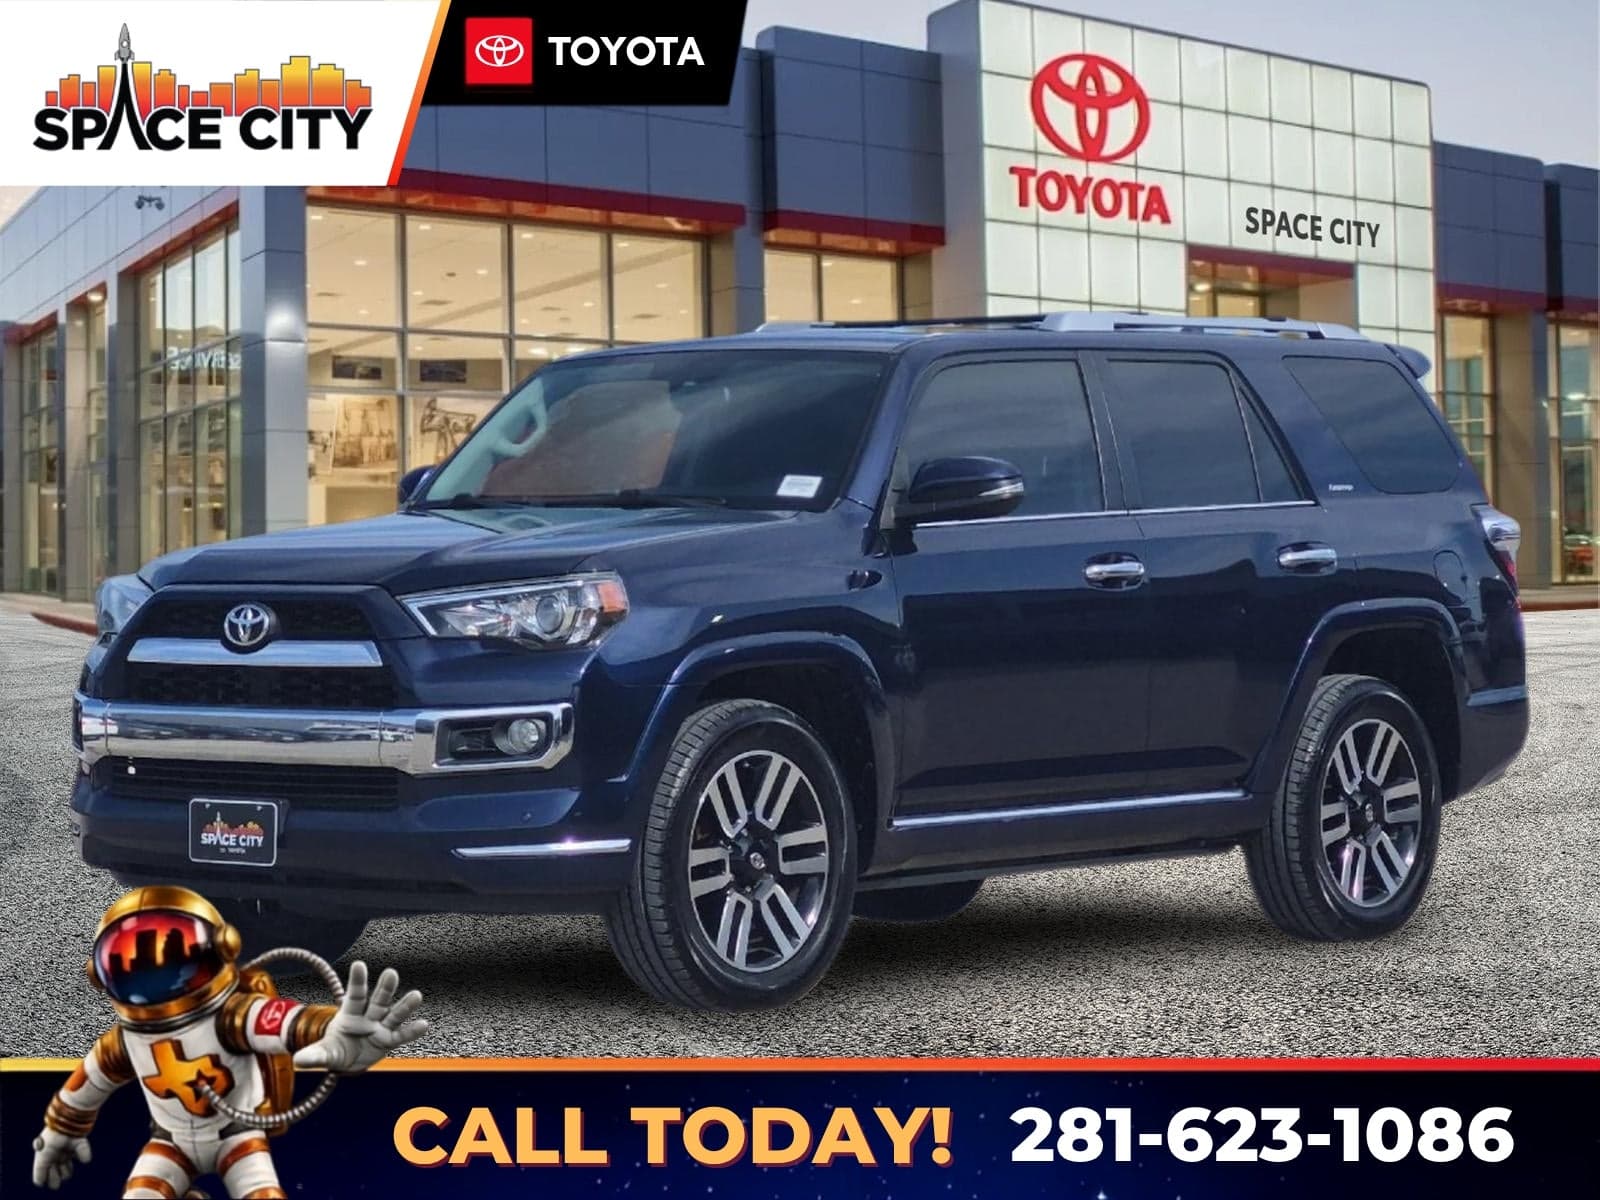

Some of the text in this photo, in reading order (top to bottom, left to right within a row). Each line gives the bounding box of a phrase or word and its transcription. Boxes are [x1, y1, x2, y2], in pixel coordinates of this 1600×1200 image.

[1010, 166, 1170, 224] TOYOTA
[1245, 206, 1380, 248] SPACE CITY
[200, 832, 264, 848] SPACE CITY
